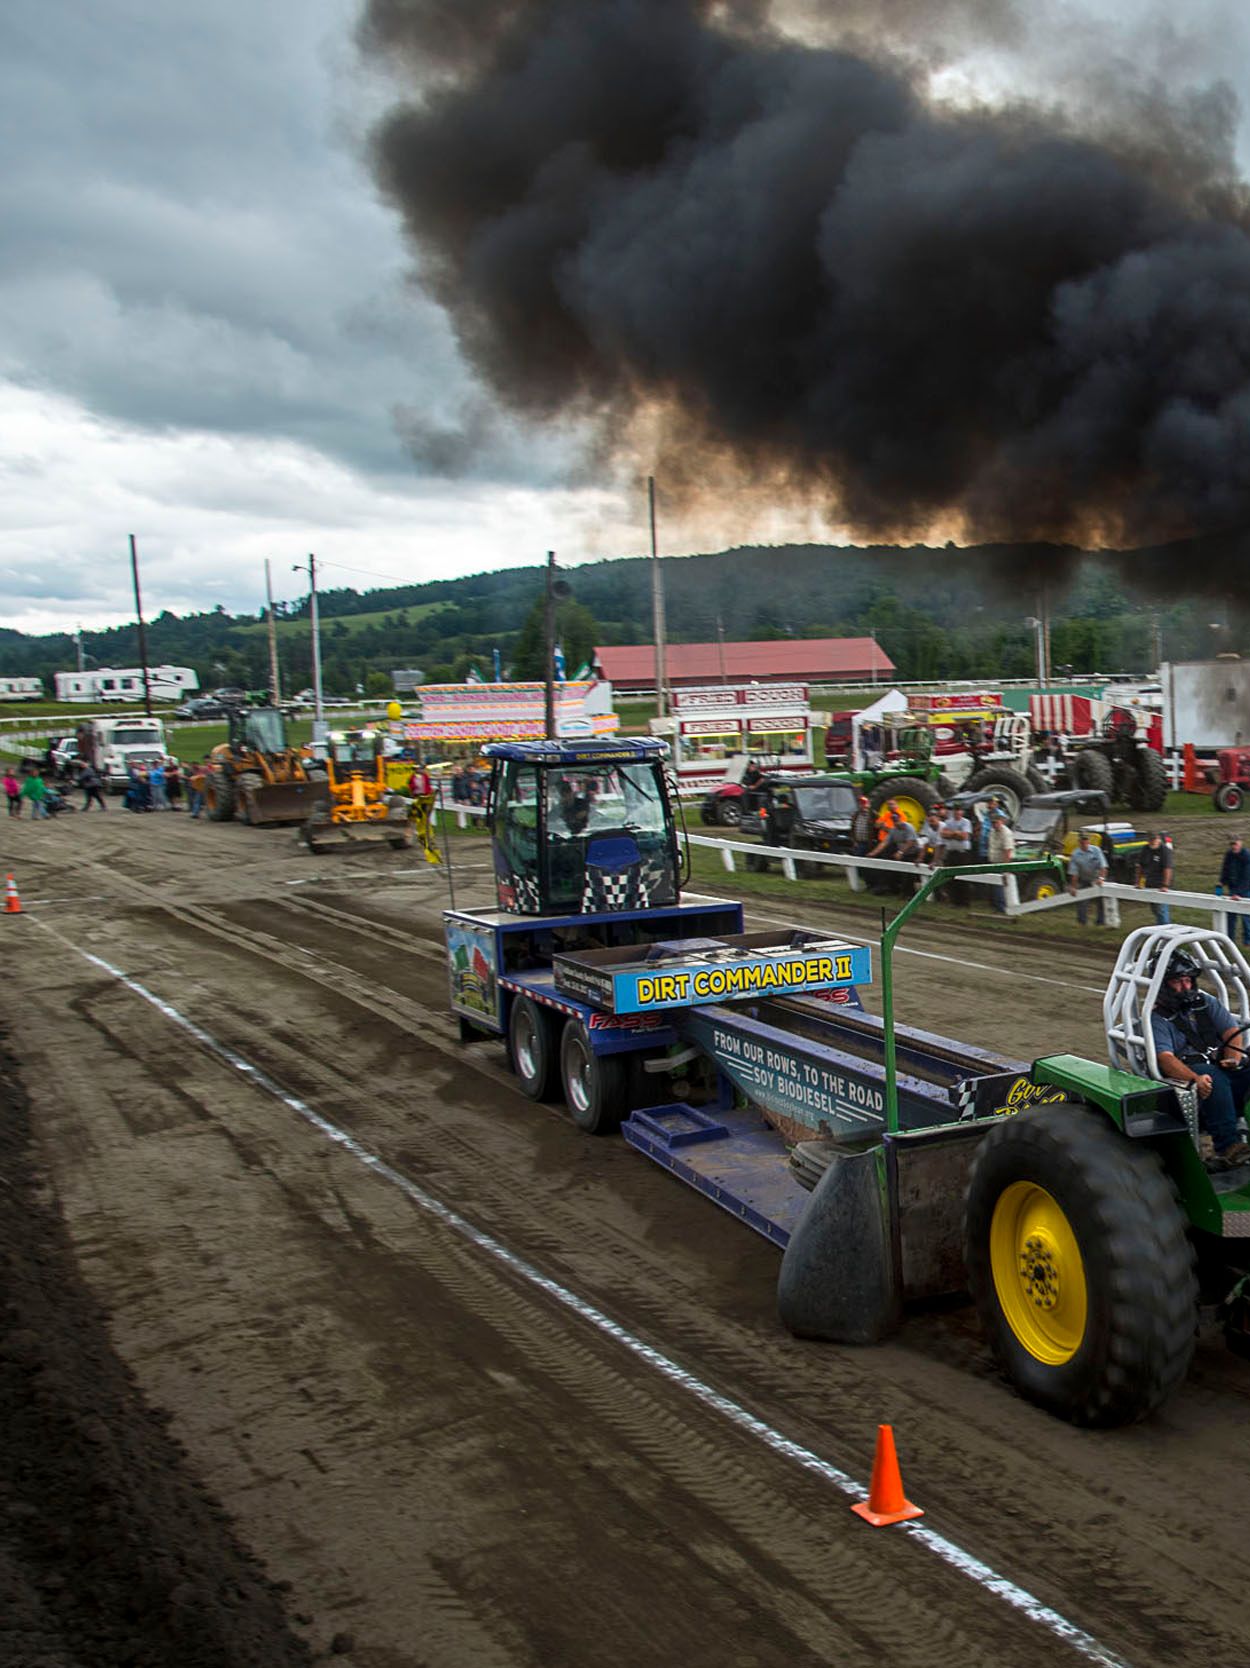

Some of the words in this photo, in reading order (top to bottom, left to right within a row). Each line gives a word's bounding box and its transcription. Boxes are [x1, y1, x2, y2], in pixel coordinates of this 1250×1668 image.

[745, 690, 803, 701] DOUGH
[689, 722, 733, 732] FRIED
[753, 719, 801, 729] DOUGH
[638, 974, 690, 1004] DIRT
[694, 958, 832, 996] COMMANDER
[836, 955, 852, 979] II
[588, 1012, 663, 1030] FASS
[713, 1030, 741, 1055] FROM
[743, 1041, 765, 1064] OUR
[767, 1050, 801, 1081] ROWS,
[804, 1064, 818, 1086] TO
[822, 1071, 846, 1097] THE
[849, 1081, 884, 1111] ROAD
[753, 1067, 774, 1089] SOY
[777, 1076, 836, 1116] BIODIESEL
